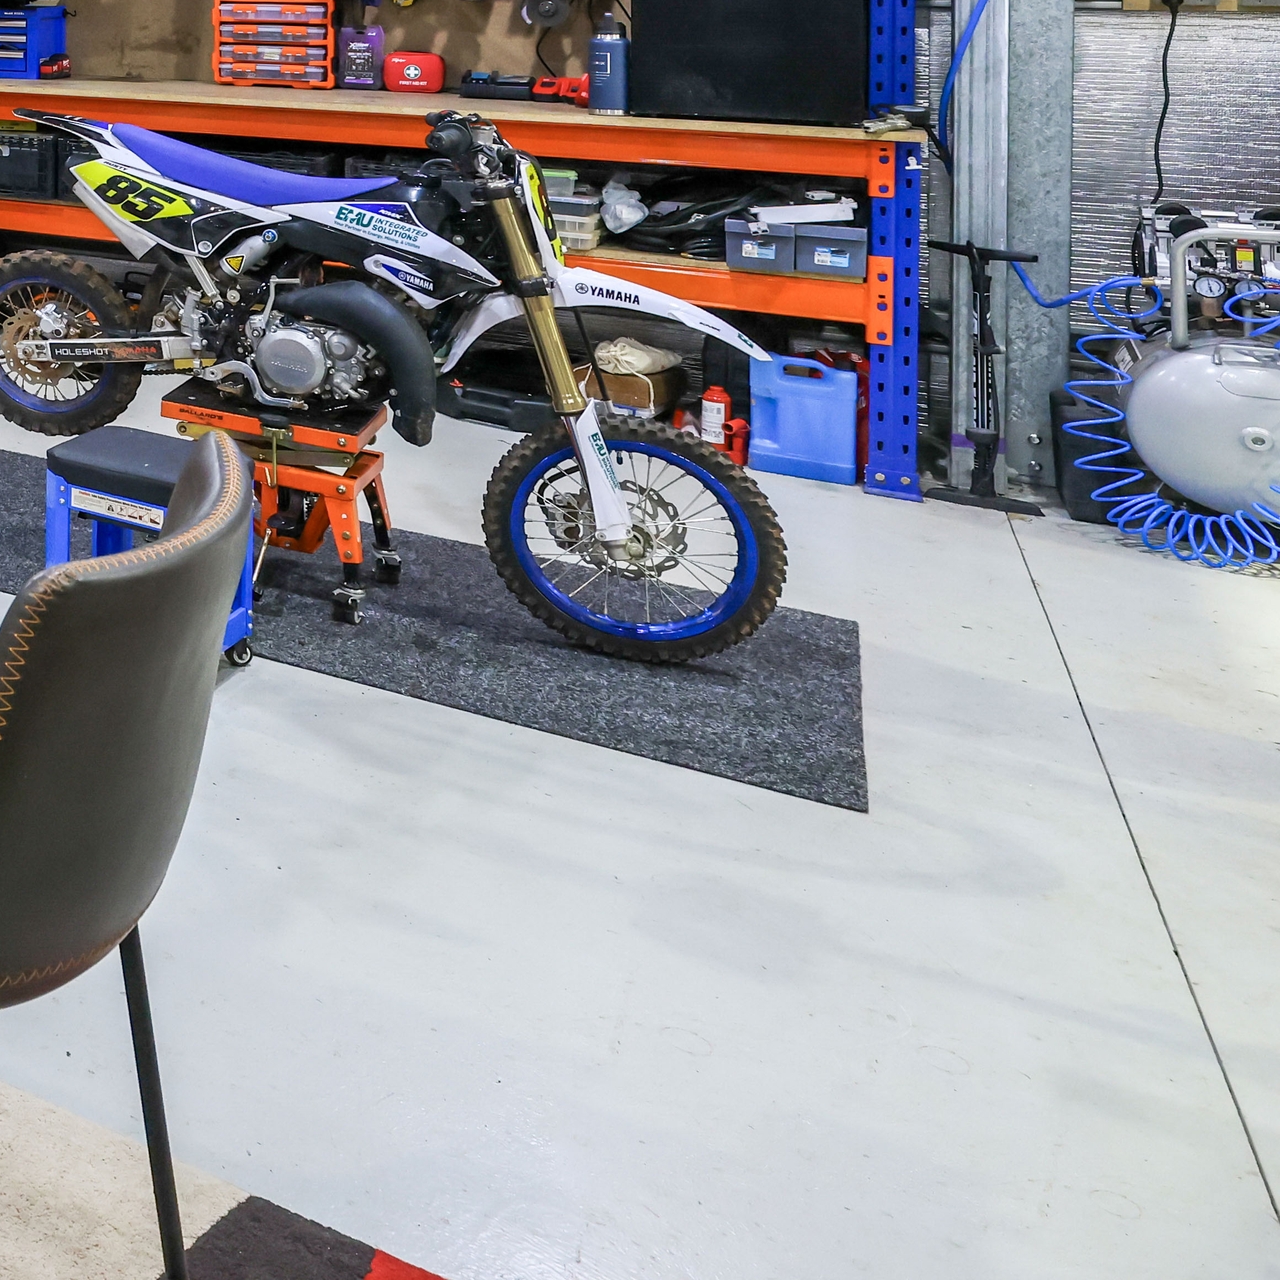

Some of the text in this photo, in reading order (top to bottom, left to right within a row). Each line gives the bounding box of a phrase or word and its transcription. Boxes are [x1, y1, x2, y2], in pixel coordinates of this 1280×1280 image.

[93, 175, 177, 220] 85
[371, 225, 419, 242] SOLUTIONS
[374, 217, 429, 238] INTEGRATED
[406, 274, 434, 291] YAMAHA
[590, 285, 641, 306] YAMAHA
[55, 348, 110, 357] HOLESHOT
